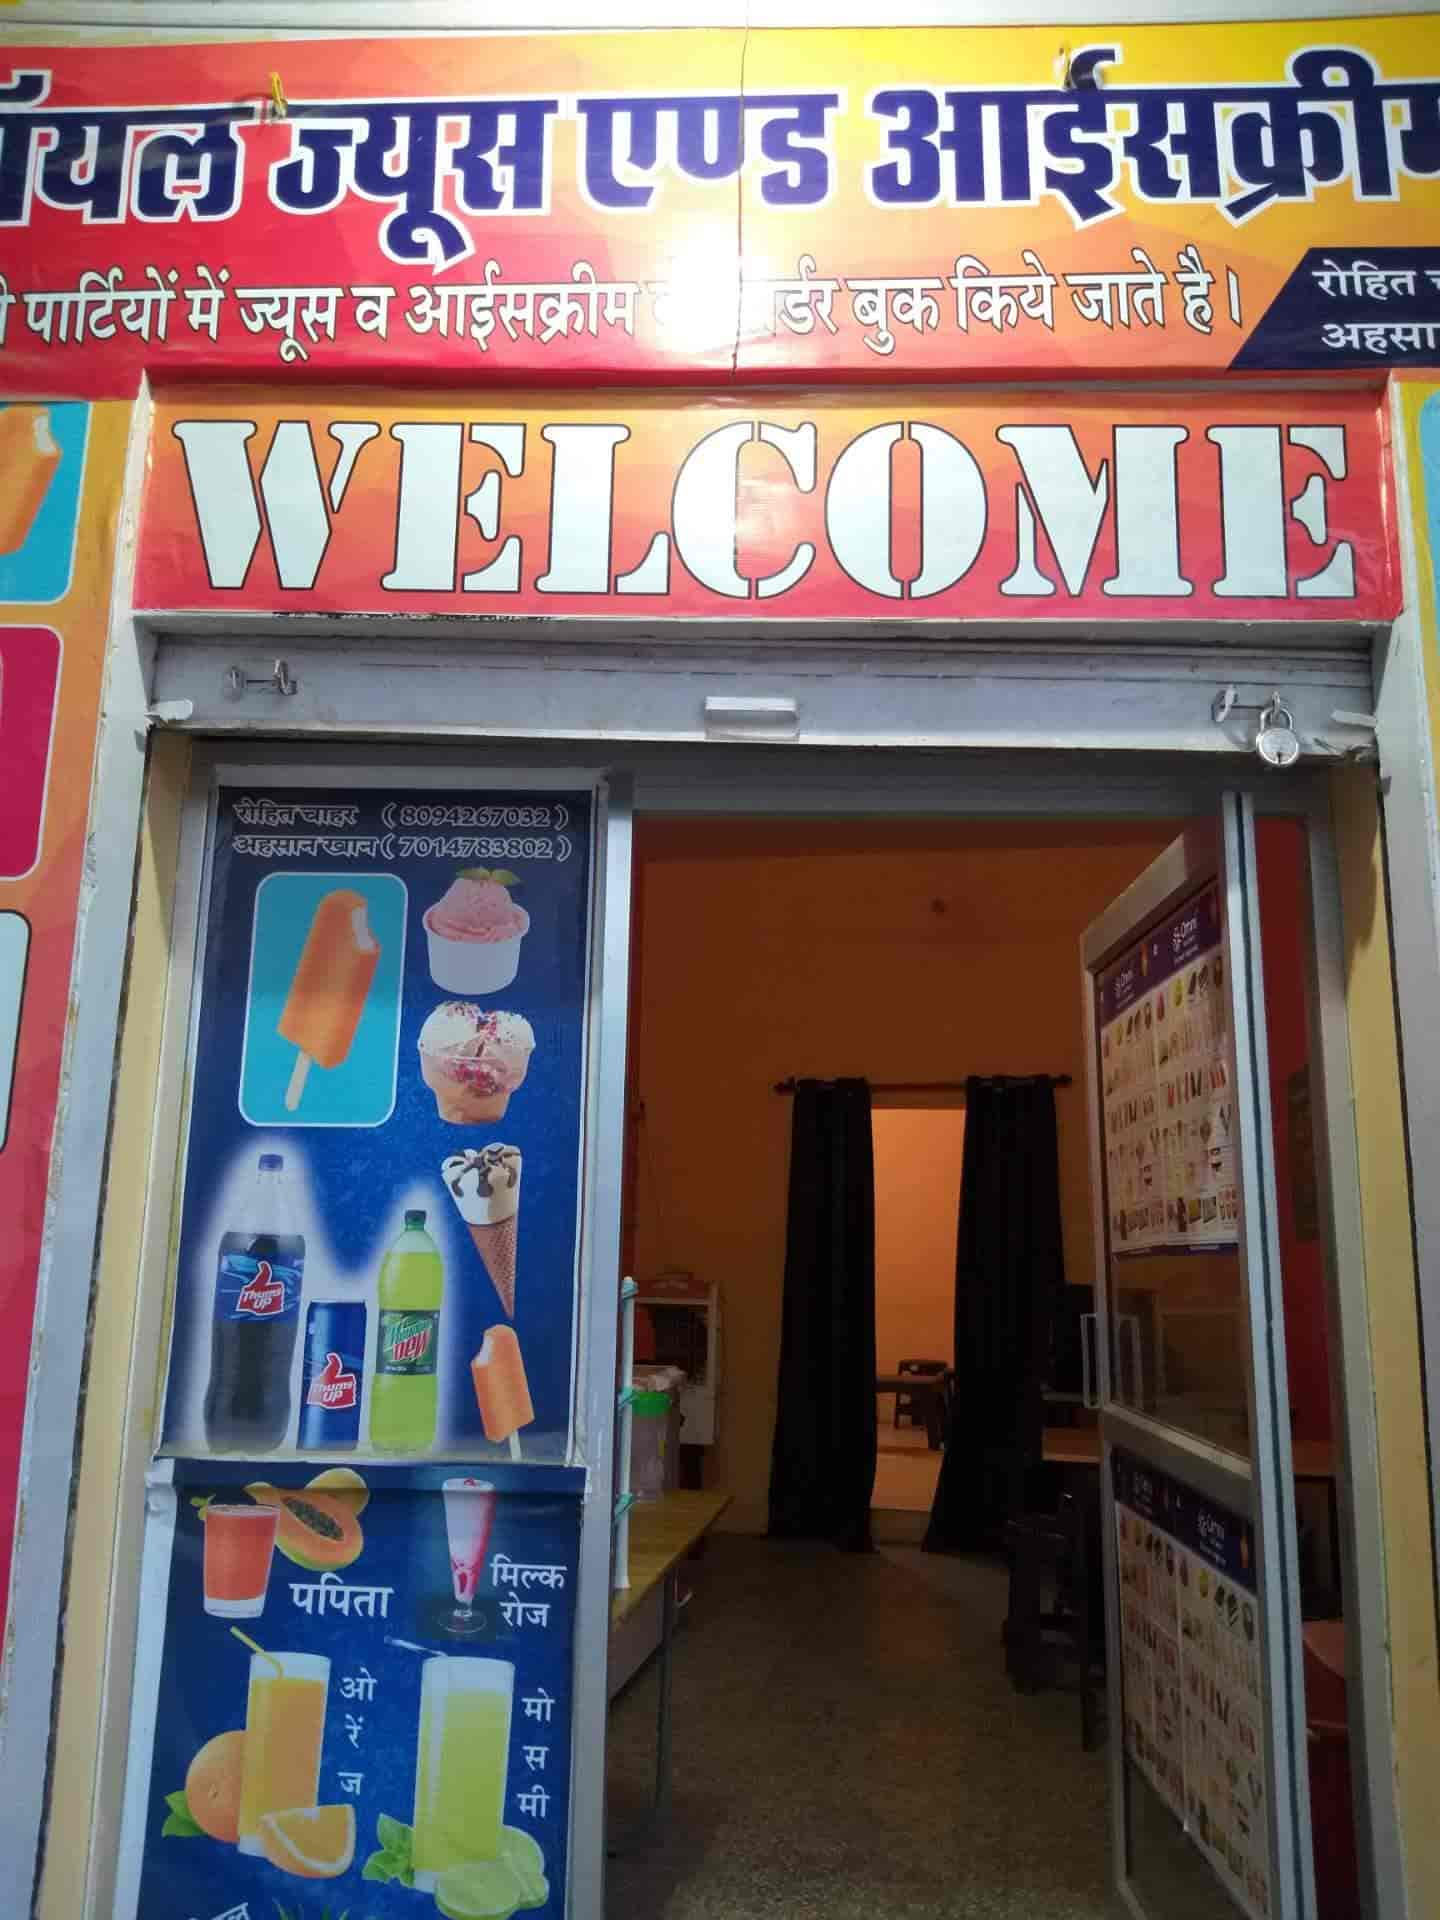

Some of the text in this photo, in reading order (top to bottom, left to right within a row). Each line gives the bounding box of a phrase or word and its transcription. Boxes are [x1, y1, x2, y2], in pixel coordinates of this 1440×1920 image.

[0, 68, 254, 225] ॉयल
[268, 100, 558, 273] ज्यूस
[574, 91, 842, 210] एण्ड
[1311, 258, 1417, 301] रोहित
[23, 265, 177, 343] पार्टियों
[183, 265, 231, 341] में
[234, 287, 344, 362] ज्यूस
[350, 284, 397, 341] व
[404, 258, 642, 352] आईसक्रीम
[844, 277, 944, 356] बुक
[947, 254, 1056, 336] किये
[1063, 246, 1168, 330] जाते
[1321, 322, 1440, 355] अहसा
[172, 420, 1357, 600] WELCOME
[232, 797, 297, 827] रोहित
[490, 1554, 567, 1589] मिल्क
[288, 1572, 394, 1618] पपिता
[499, 1592, 550, 1628] रोज
